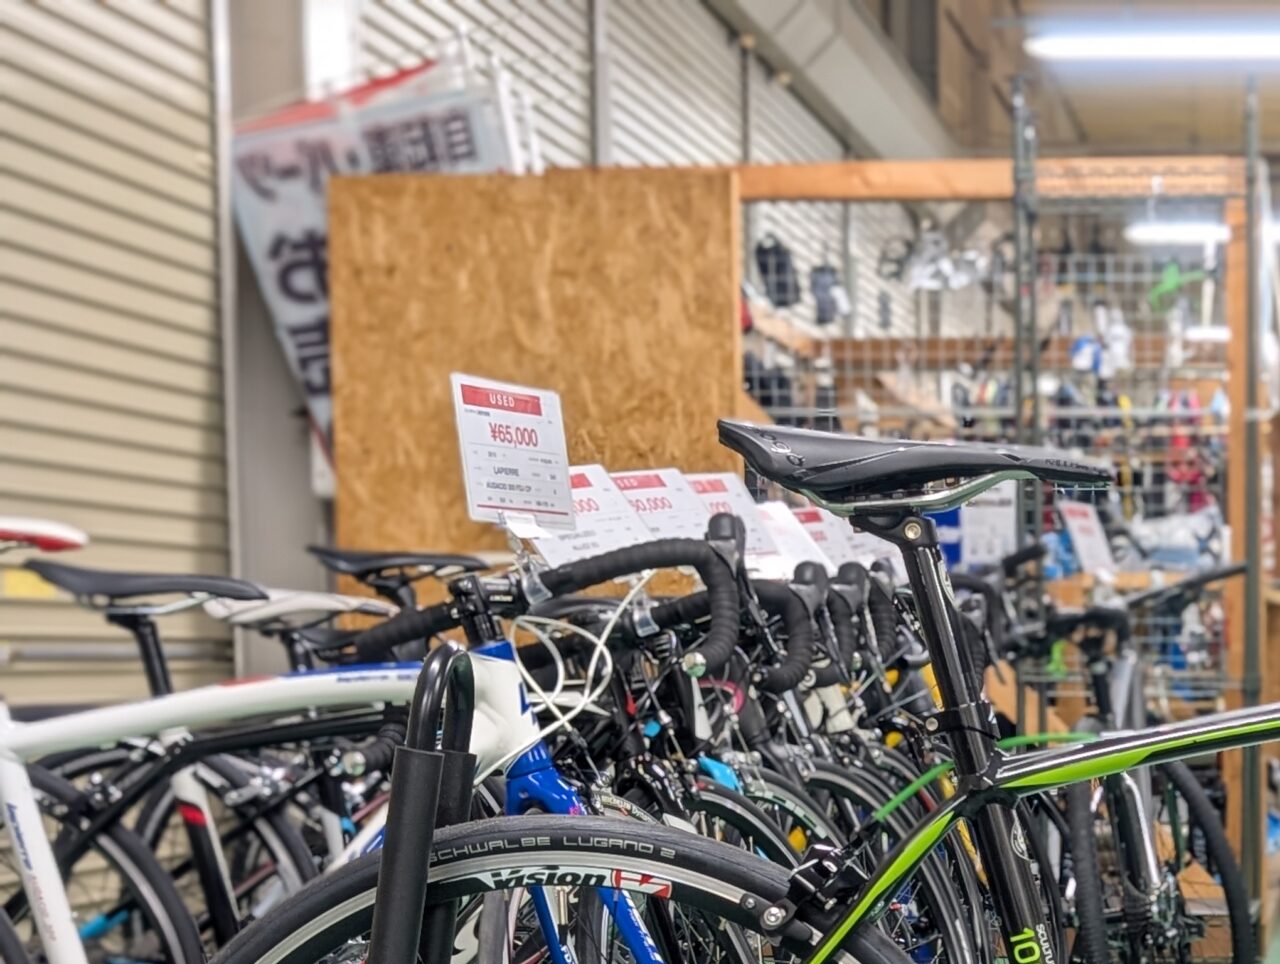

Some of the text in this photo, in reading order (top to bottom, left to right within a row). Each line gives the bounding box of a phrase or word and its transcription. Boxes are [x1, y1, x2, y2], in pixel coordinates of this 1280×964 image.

[488, 393, 516, 408] USED
[488, 421, 539, 448] ¥65,000
[428, 836, 676, 862] SCHWALBE LUGANO 2
[492, 868, 607, 887] Vision
